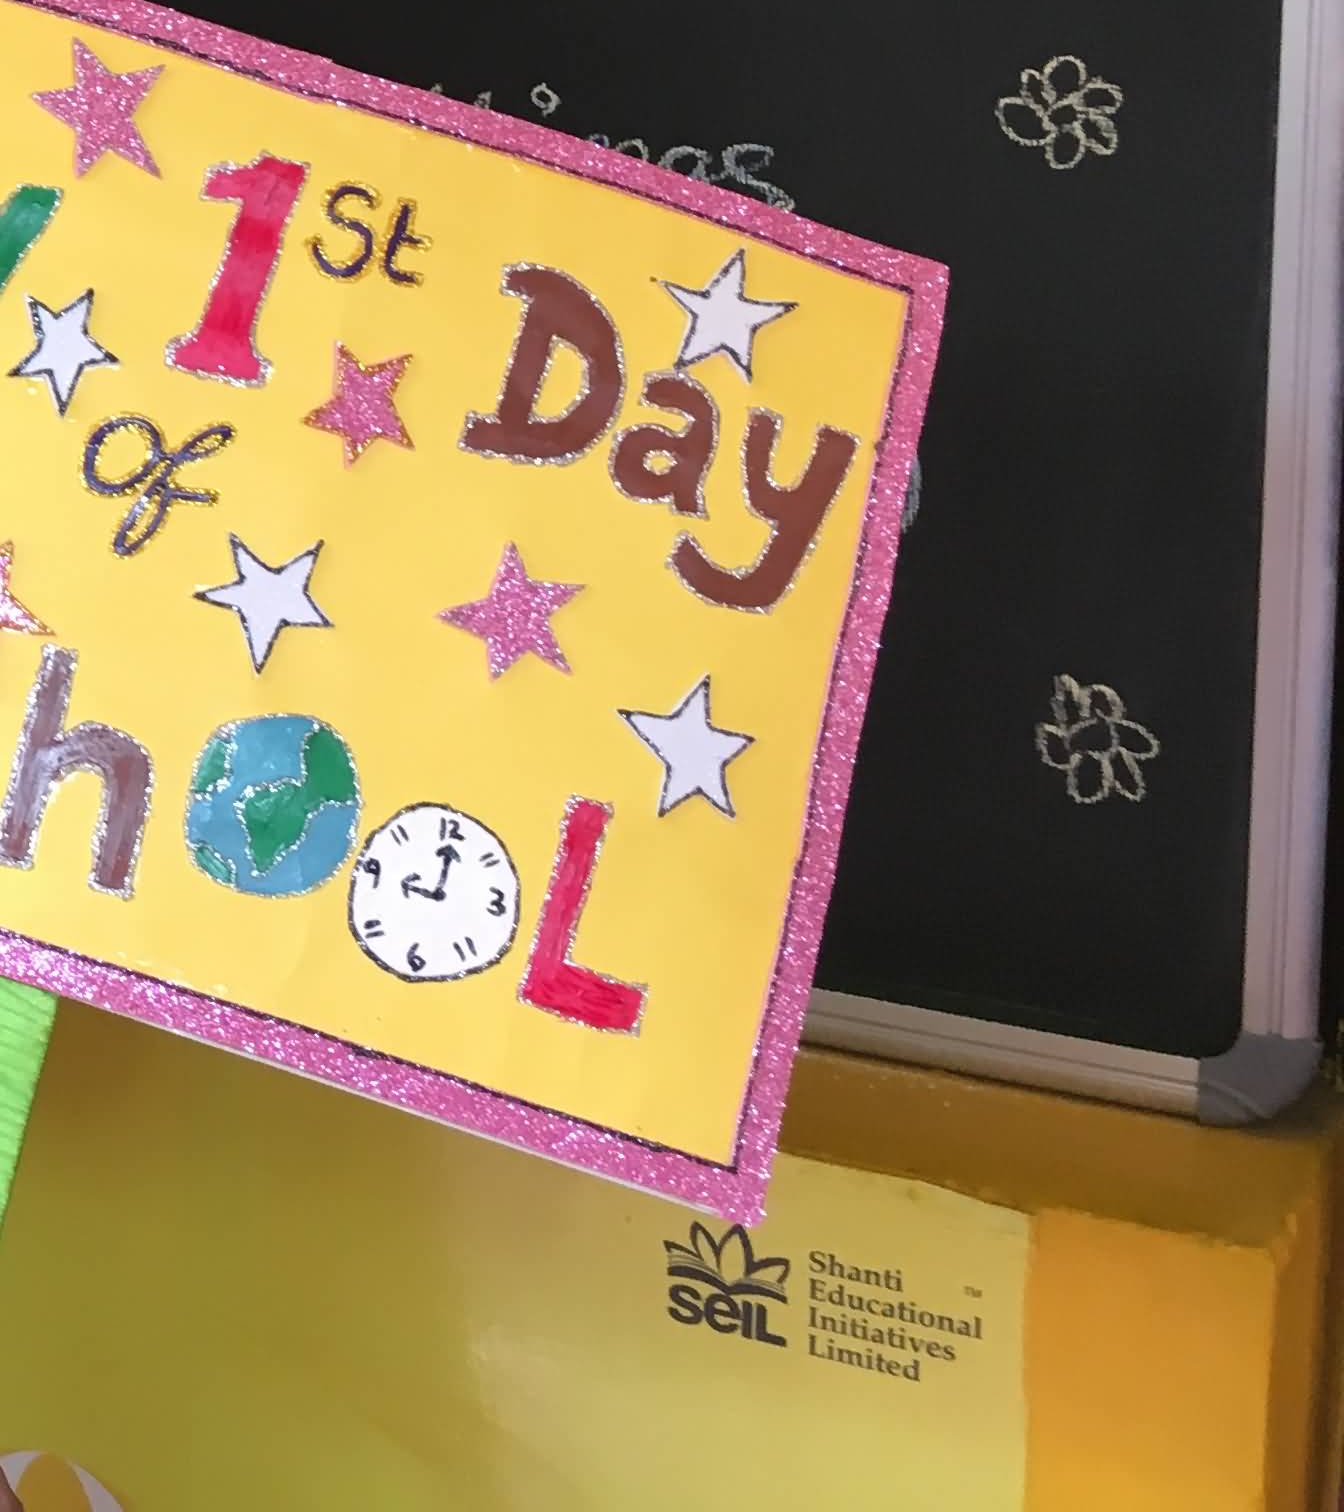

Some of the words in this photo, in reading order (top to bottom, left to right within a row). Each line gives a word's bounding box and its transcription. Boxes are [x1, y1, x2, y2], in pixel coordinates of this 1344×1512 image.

[457, 259, 862, 614] Day
[81, 411, 238, 559] of
[808, 1250, 903, 1293] Shanti
[808, 1278, 984, 1340] Educational
[808, 1306, 957, 1362] Initiatives
[808, 1334, 921, 1383] Limited
